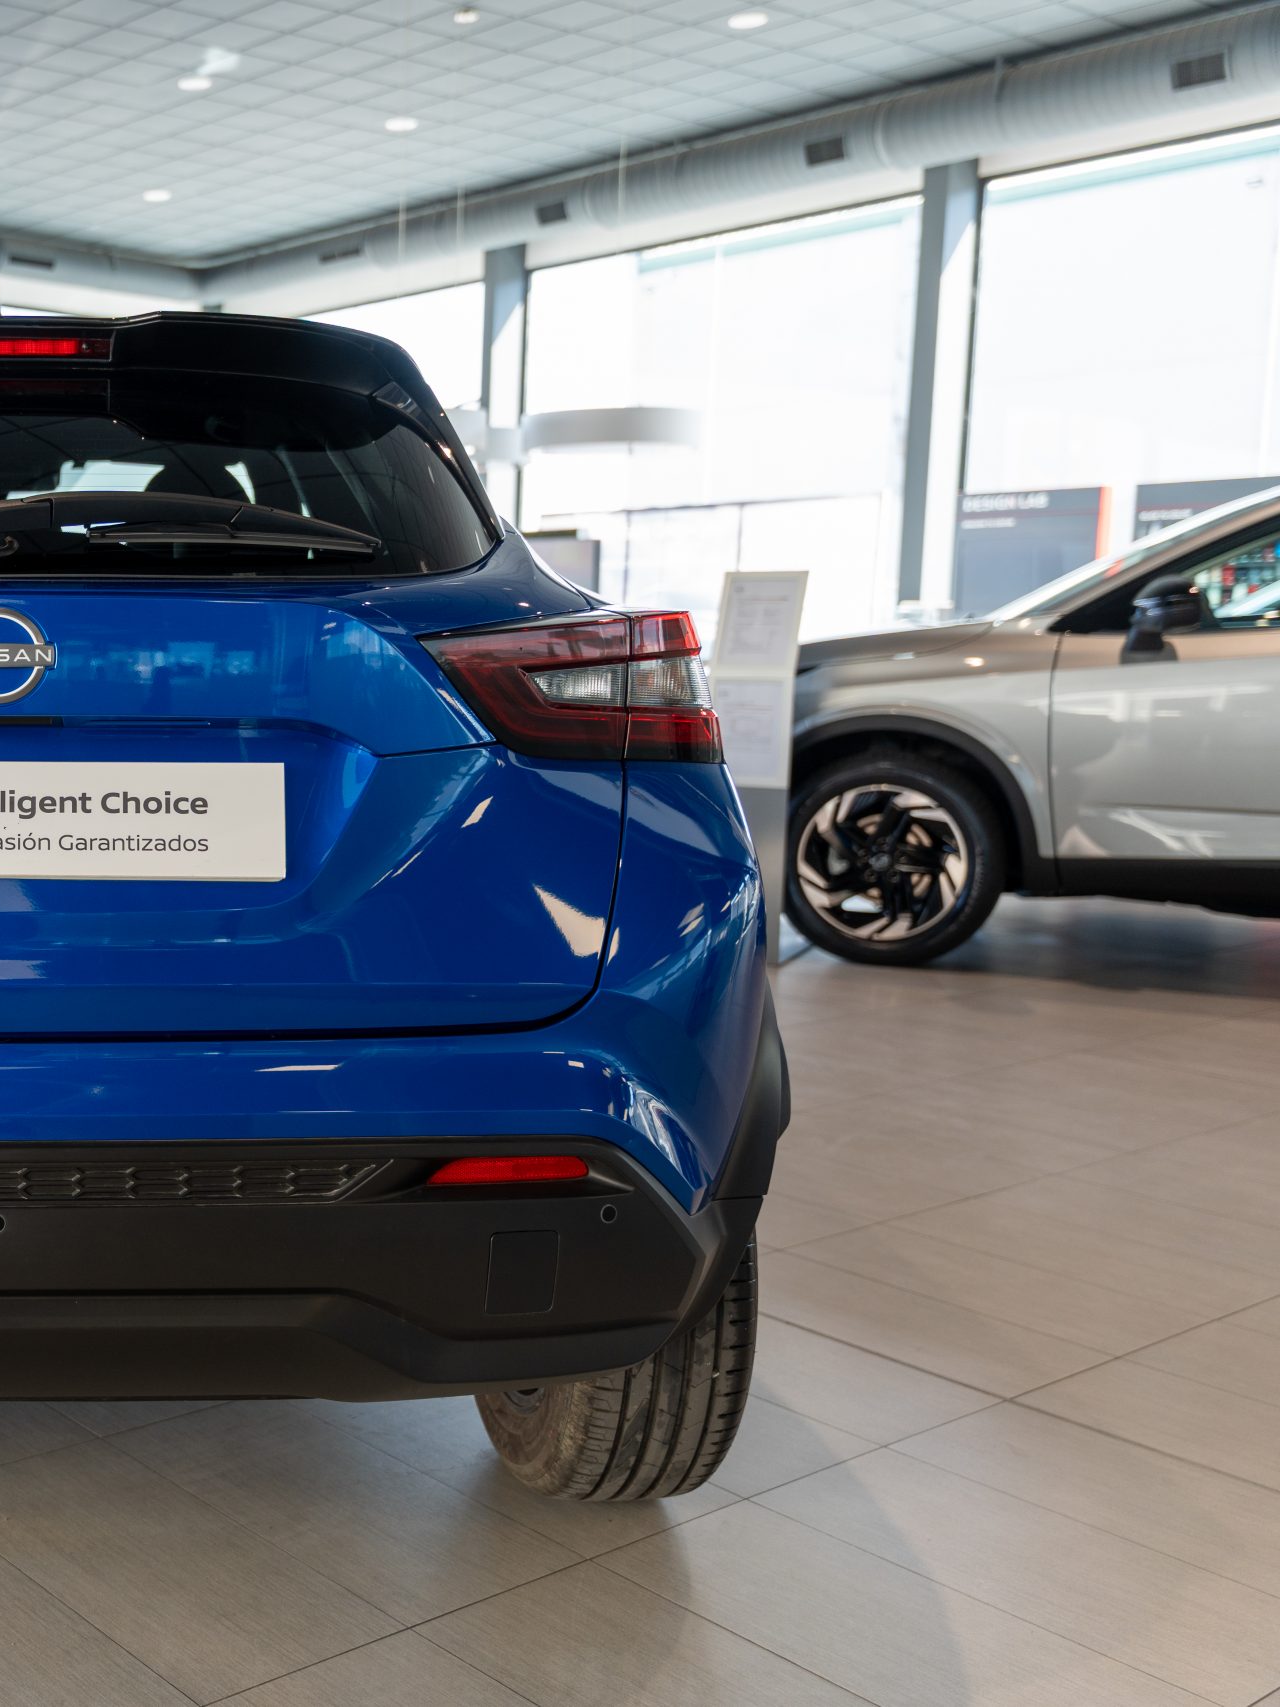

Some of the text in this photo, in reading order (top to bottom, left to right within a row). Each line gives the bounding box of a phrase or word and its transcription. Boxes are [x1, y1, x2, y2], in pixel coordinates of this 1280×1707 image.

[962, 491, 1049, 513] DESIGN LAB
[100, 790, 209, 815] Choice
[58, 833, 209, 852] Garantizados
